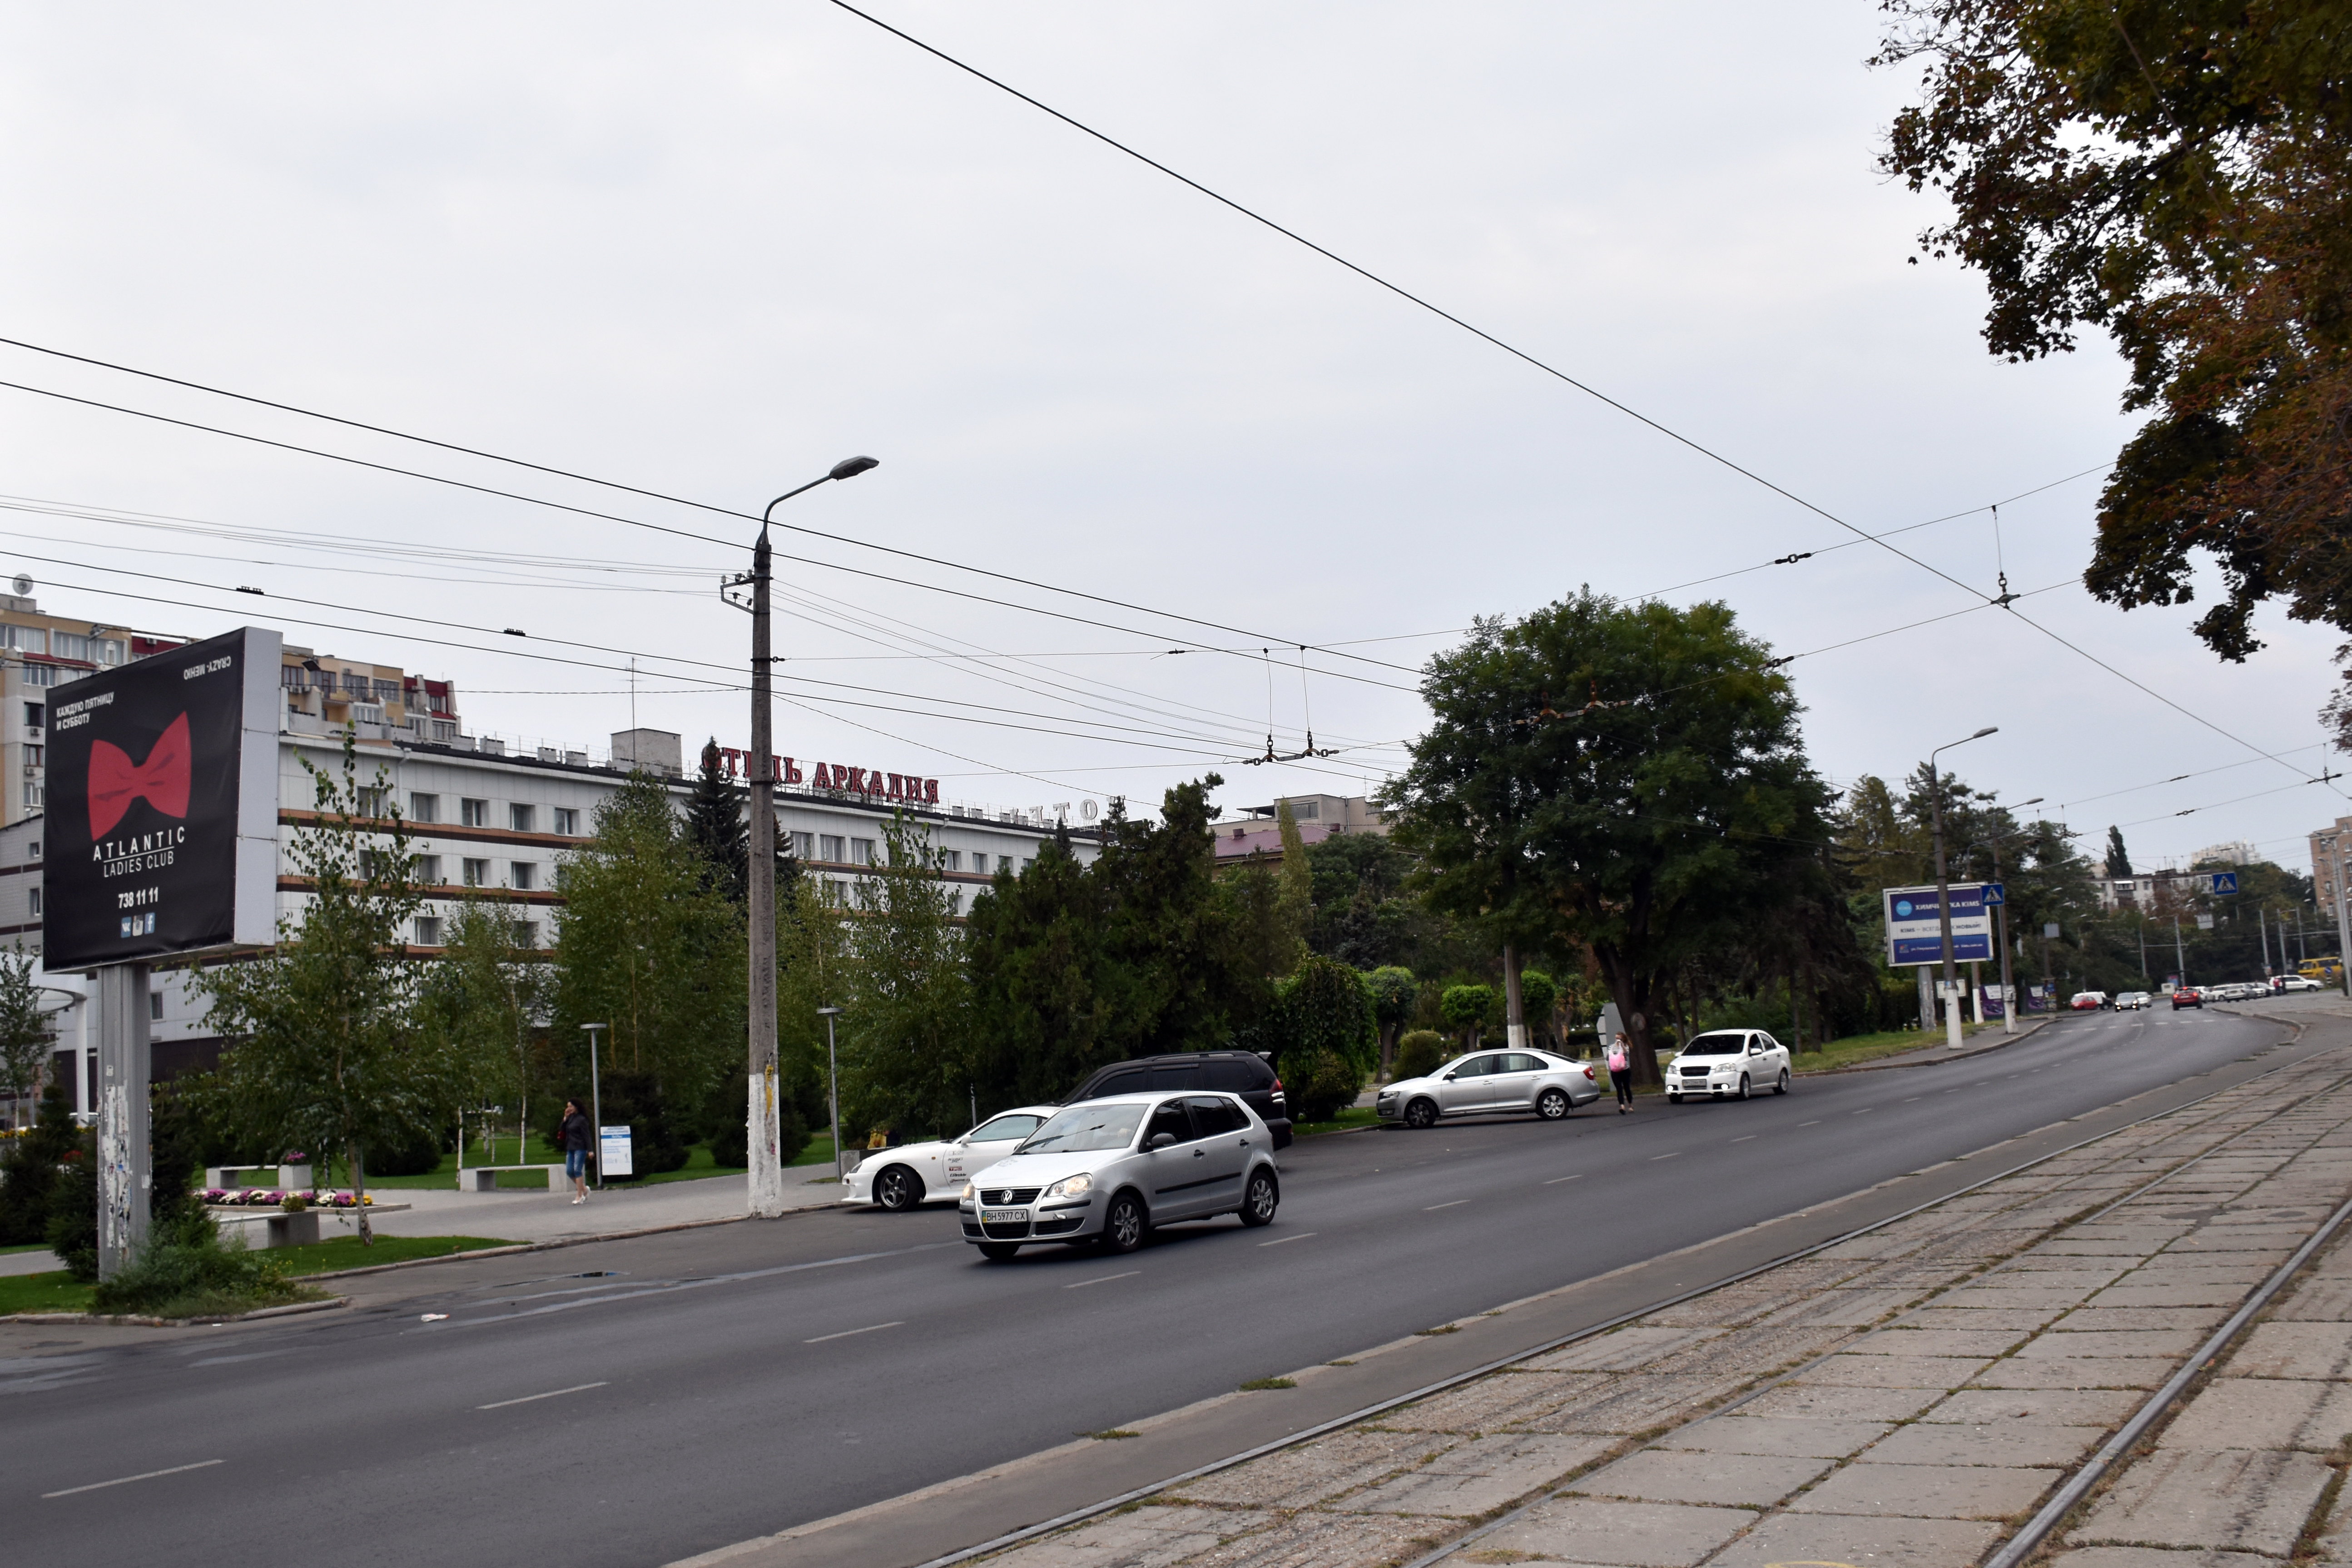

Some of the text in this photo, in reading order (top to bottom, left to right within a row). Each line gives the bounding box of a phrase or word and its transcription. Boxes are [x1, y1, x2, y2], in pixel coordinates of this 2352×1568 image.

[184, 664, 205, 680] МЕНЮ
[56, 691, 114, 718] КАЖДУЮ ПЯТНИЦУ
[56, 712, 90, 731] И СУББОТУ
[814, 762, 939, 804] АРКАДИЯ
[93, 826, 185, 861] ATLANTIC
[104, 851, 174, 878] LADIES CLUB
[118, 887, 159, 908] 738 11 11
[1915, 901, 1961, 910] ХИМЧКА
[987, 1211, 1025, 1221] BH 5977 CX
